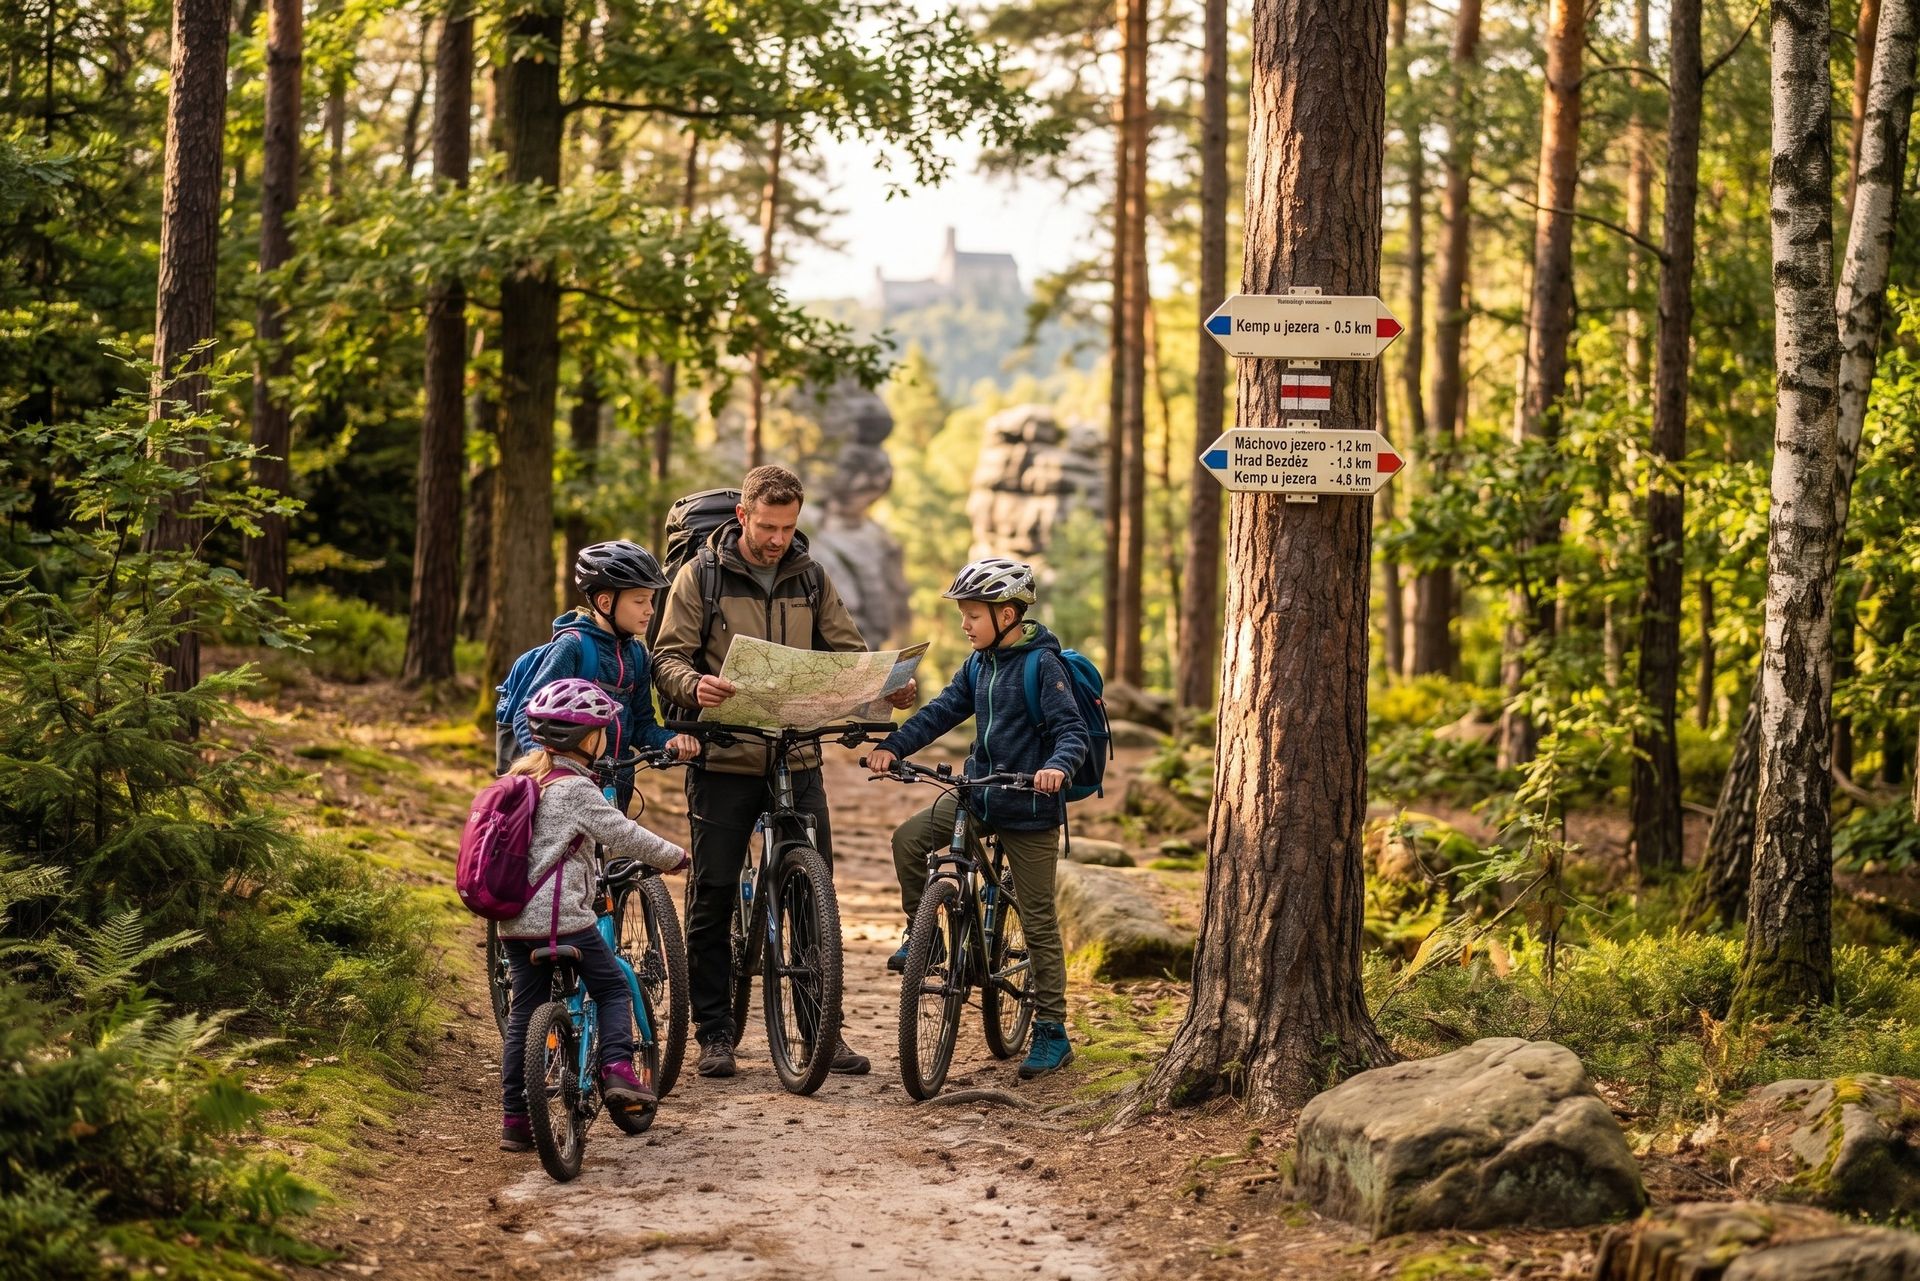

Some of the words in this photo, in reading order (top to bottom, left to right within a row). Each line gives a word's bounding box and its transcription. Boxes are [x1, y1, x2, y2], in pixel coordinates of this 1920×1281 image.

[1236, 319, 1270, 335] Kemp
[1273, 323, 1281, 332] u
[1284, 320, 1319, 336] jezera
[1334, 320, 1351, 334] 0.5
[1354, 321, 1372, 334] km
[1290, 438, 1326, 454] jezero
[1337, 440, 1352, 453] 1,2
[1355, 440, 1372, 452] km
[1235, 454, 1262, 466] Hrad
[1355, 457, 1372, 469] km
[1234, 471, 1268, 486] Kemp
[1272, 474, 1278, 483] u
[1281, 471, 1317, 487] jezera
[1355, 474, 1371, 486] km
